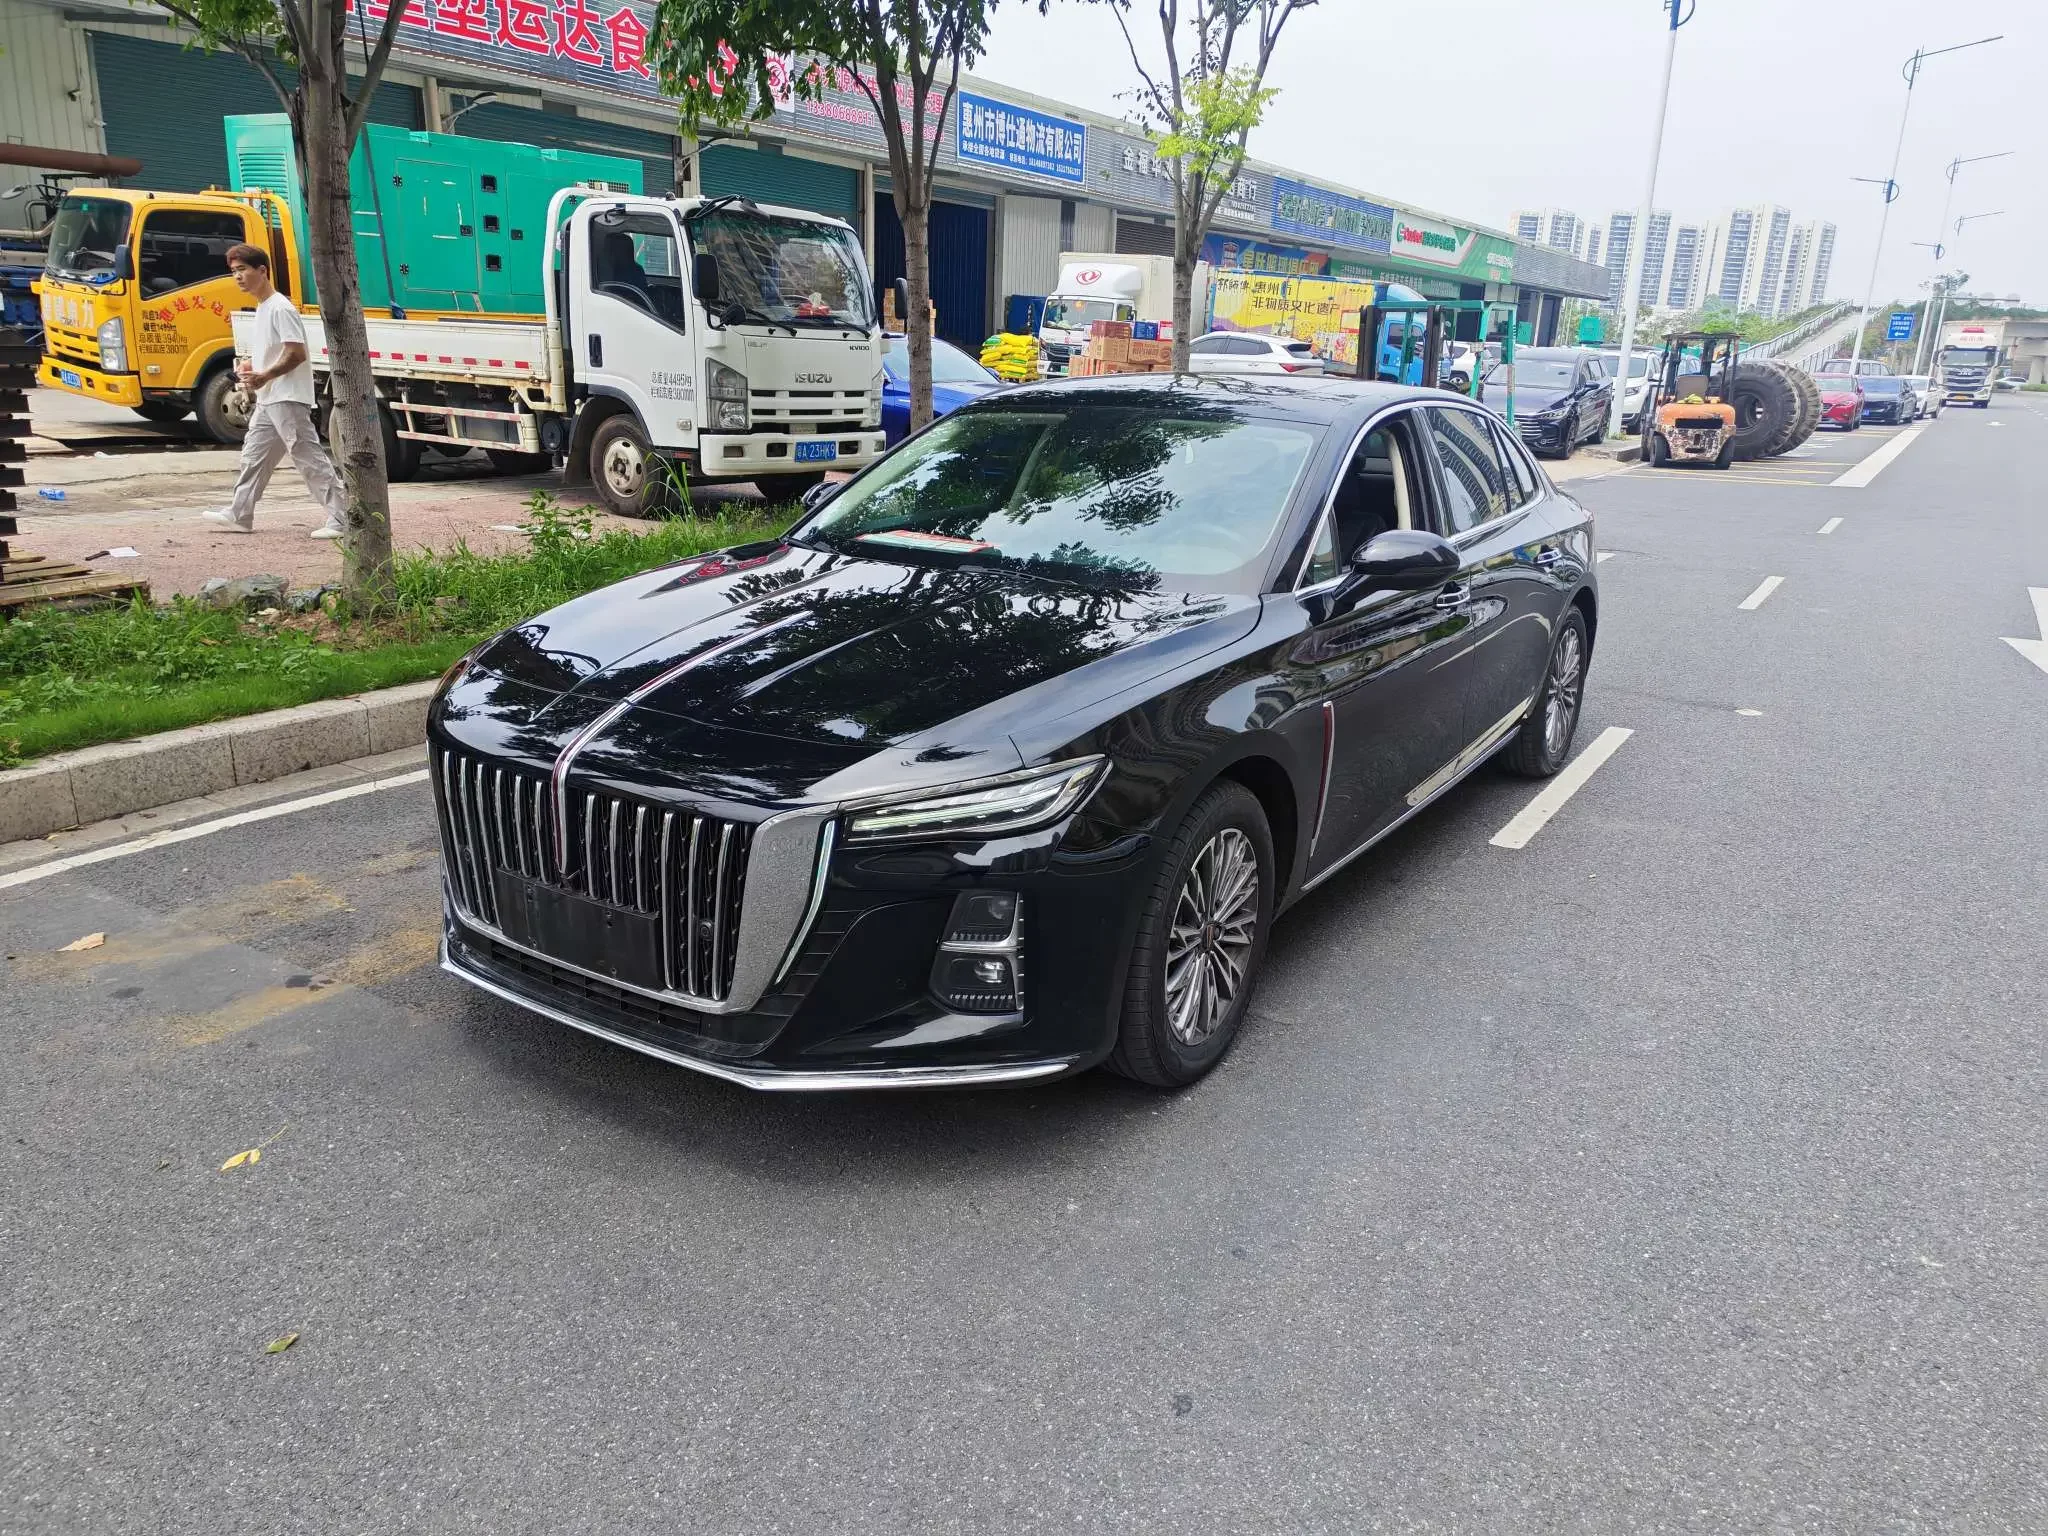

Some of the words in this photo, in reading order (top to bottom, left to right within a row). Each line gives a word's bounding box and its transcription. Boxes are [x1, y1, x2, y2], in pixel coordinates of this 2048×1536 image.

[962, 101, 1082, 164] 惠州市博仕通物流有限公司
[1252, 296, 1340, 315] 非物质文化遗产
[795, 372, 833, 384] ISUZU
